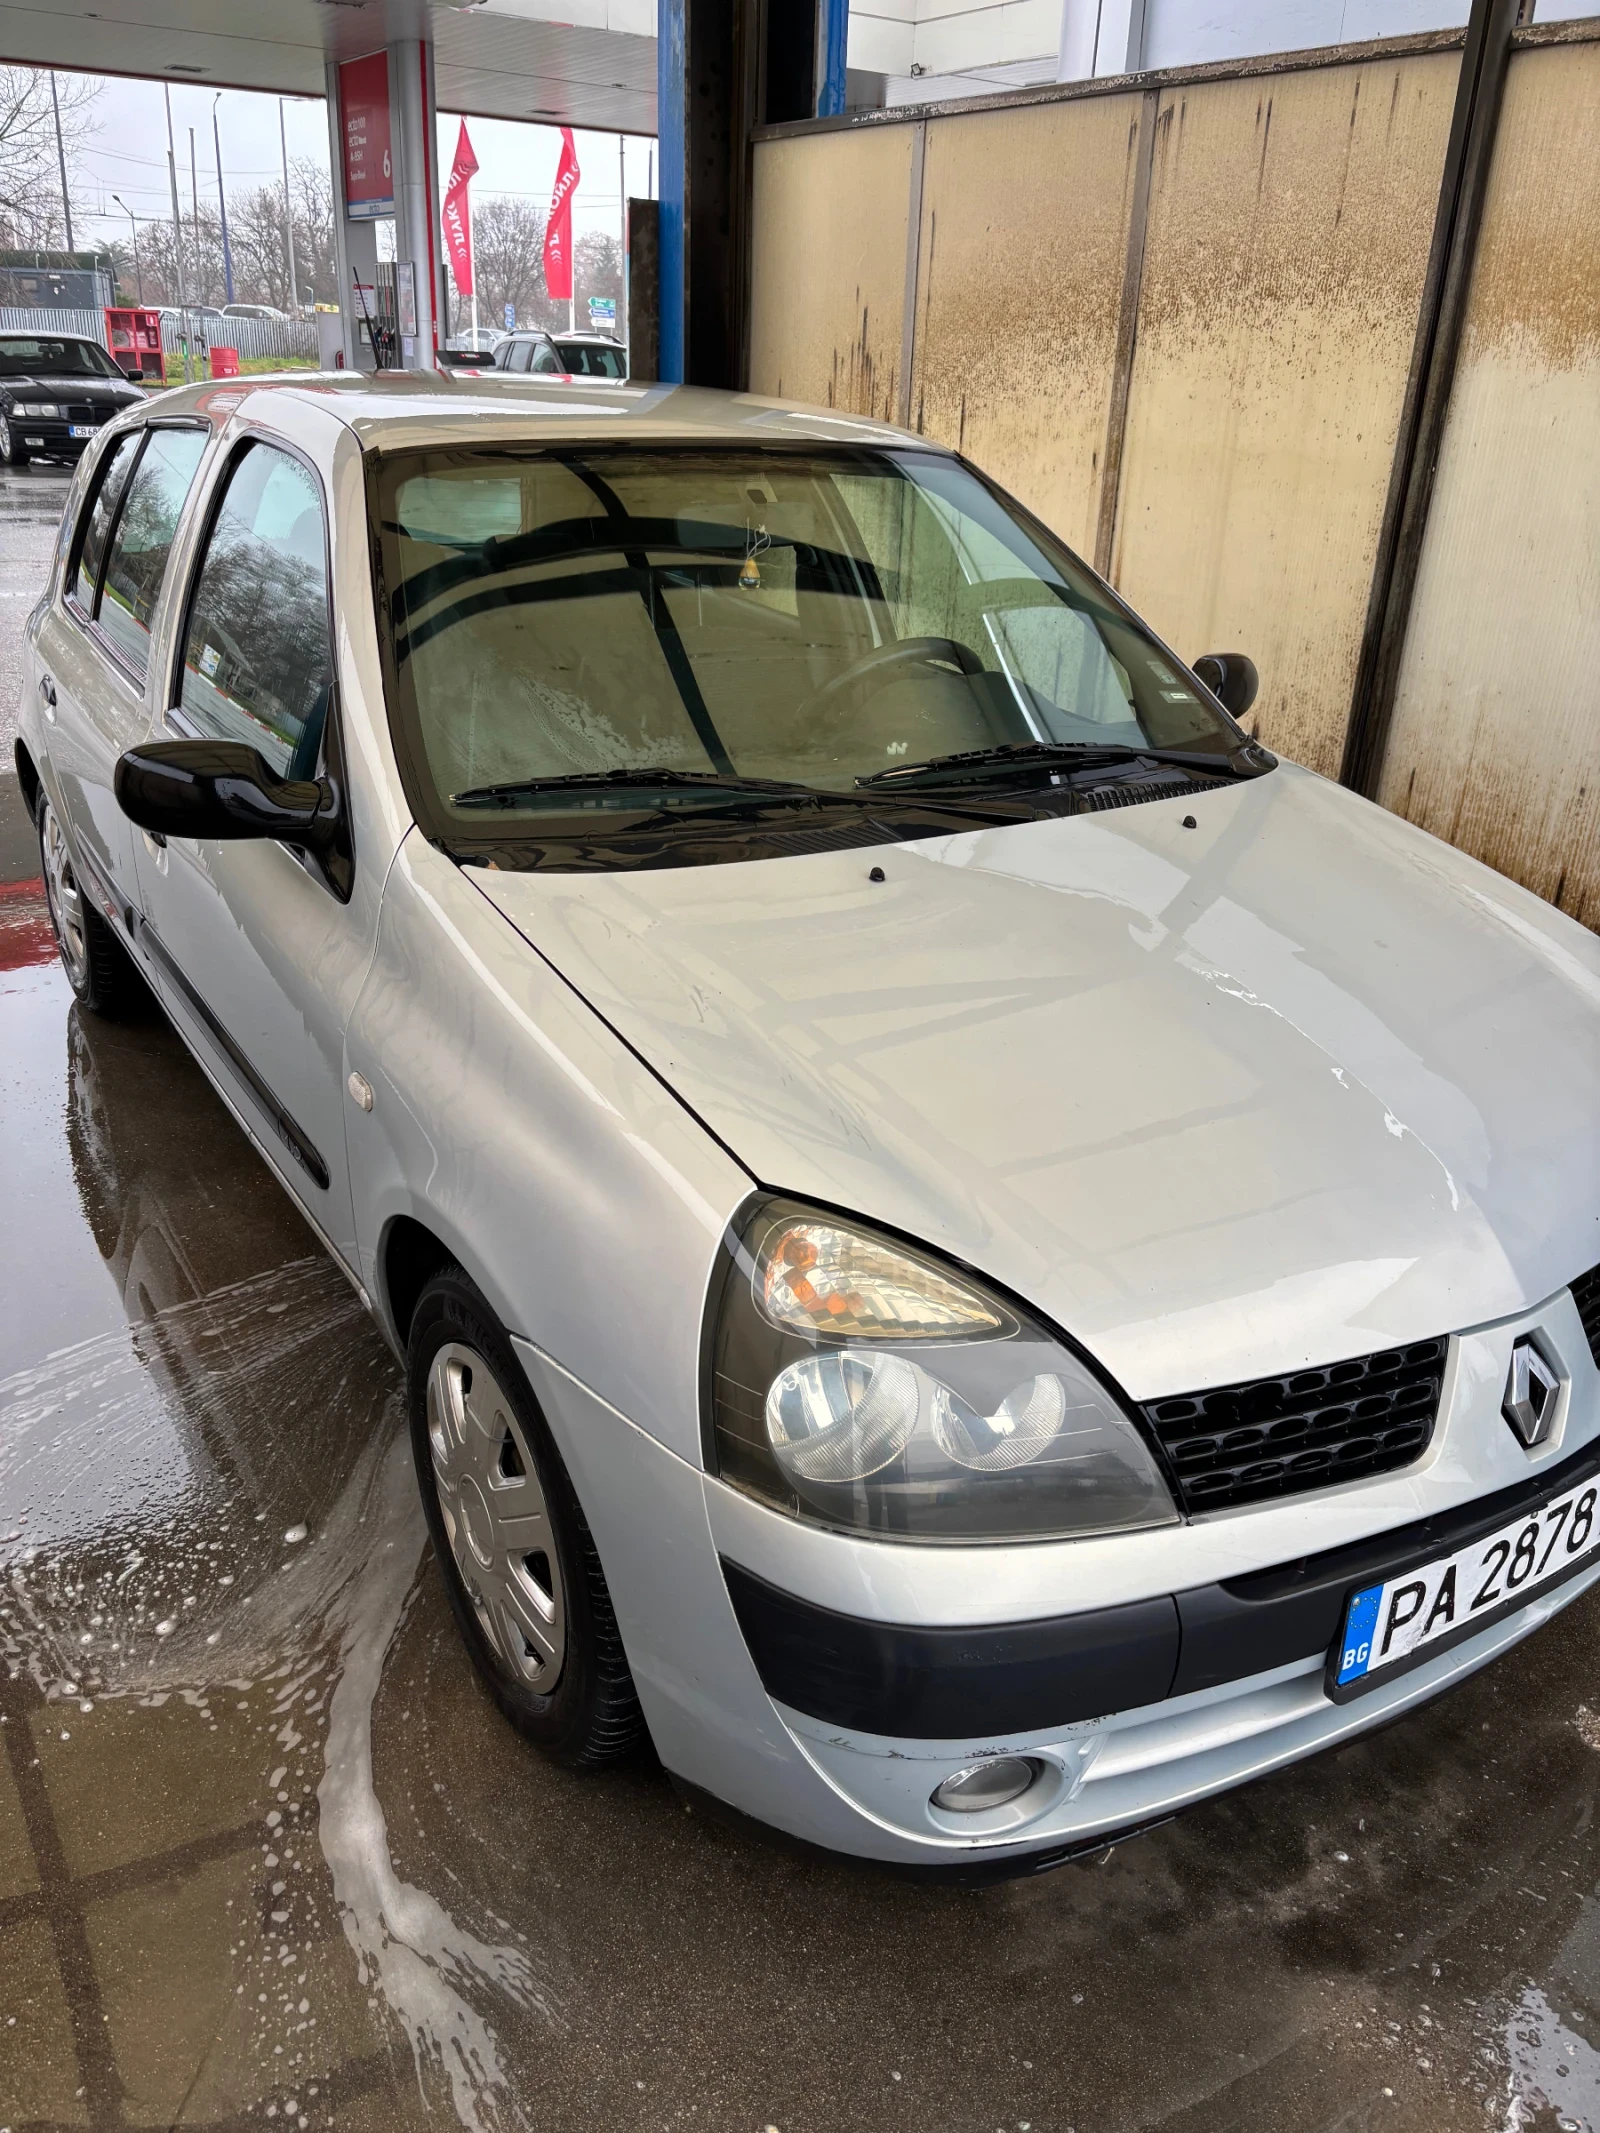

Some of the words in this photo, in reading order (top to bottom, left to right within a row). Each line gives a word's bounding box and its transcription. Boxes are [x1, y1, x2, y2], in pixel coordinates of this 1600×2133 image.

[383, 149, 391, 179] 6
[75, 427, 87, 436] CB
[1379, 1564, 1457, 1657] PA
[1469, 1487, 1598, 1613] 2878
[1342, 1642, 1369, 1670] BG
